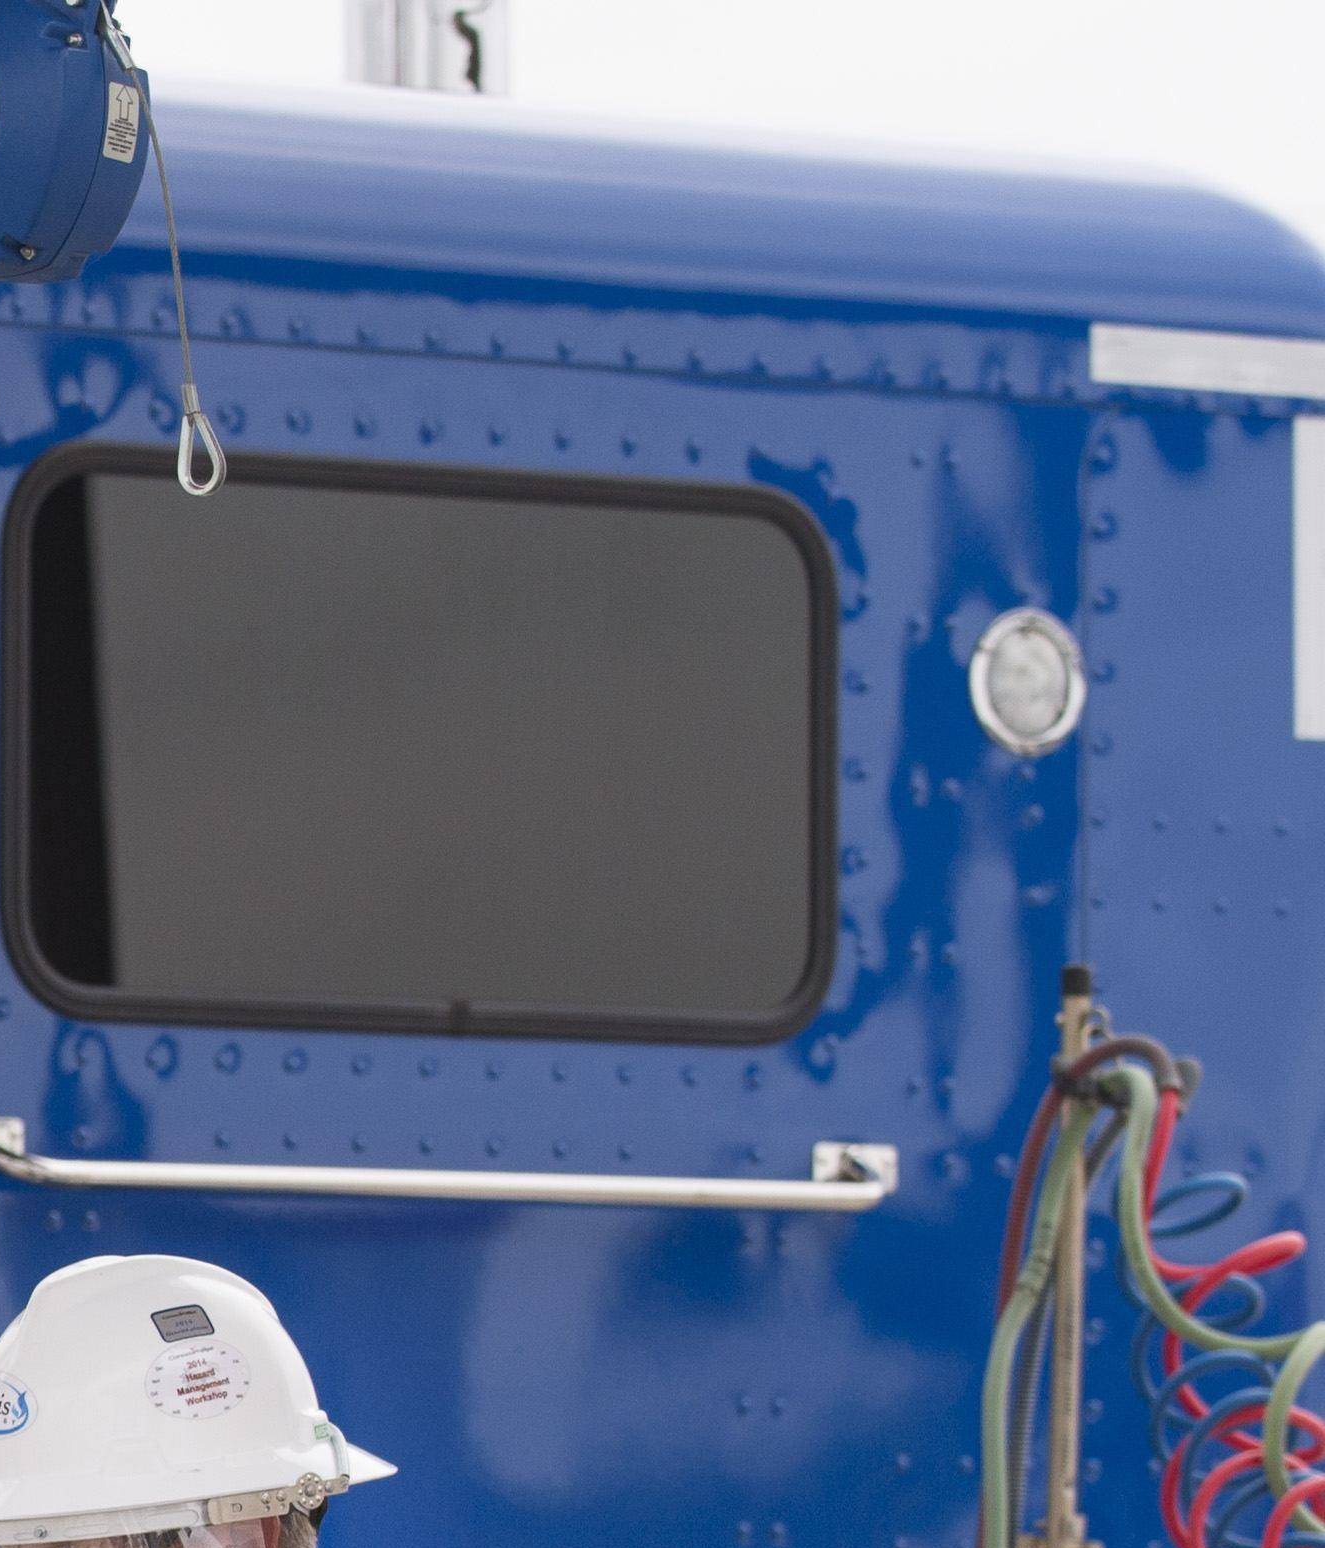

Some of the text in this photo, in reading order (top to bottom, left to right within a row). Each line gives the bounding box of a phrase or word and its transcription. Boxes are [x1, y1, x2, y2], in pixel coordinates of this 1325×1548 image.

[186, 1359, 207, 1370] 2014
[185, 1368, 216, 1382] Hazard
[176, 1377, 231, 1397] Management
[185, 1391, 228, 1407] Workshop
